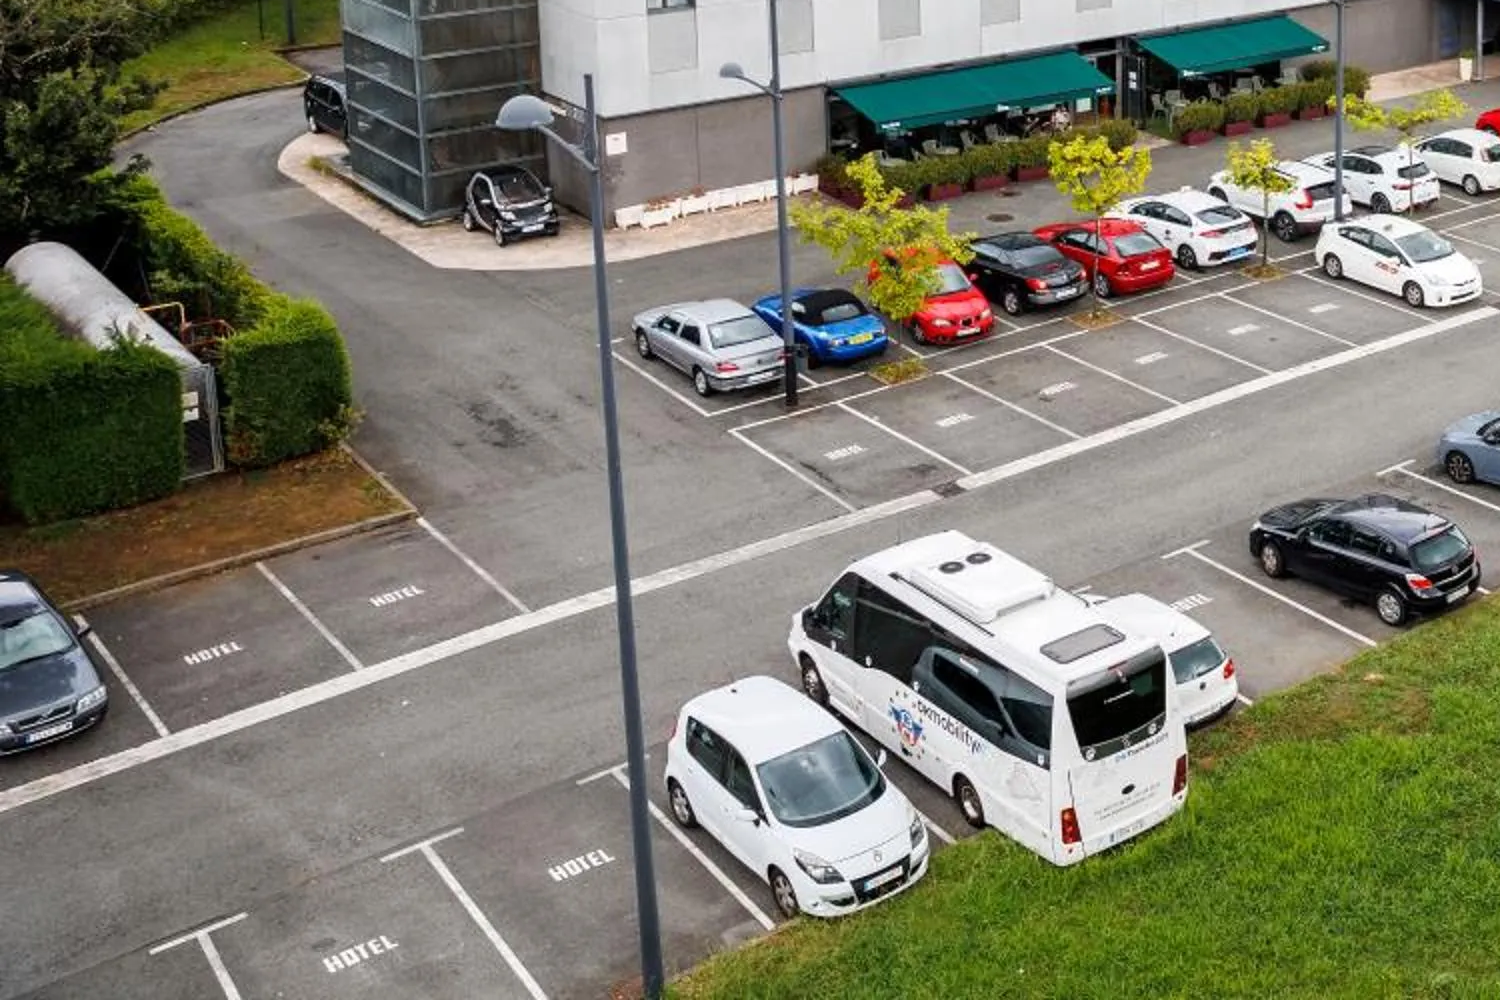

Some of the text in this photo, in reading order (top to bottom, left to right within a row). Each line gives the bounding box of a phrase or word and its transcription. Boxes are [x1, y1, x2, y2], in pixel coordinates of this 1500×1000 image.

[369, 585, 425, 607] HOTEL
[183, 641, 244, 665] HOTEL
[547, 849, 616, 882] HOTEL
[322, 935, 399, 973] HOTEL
